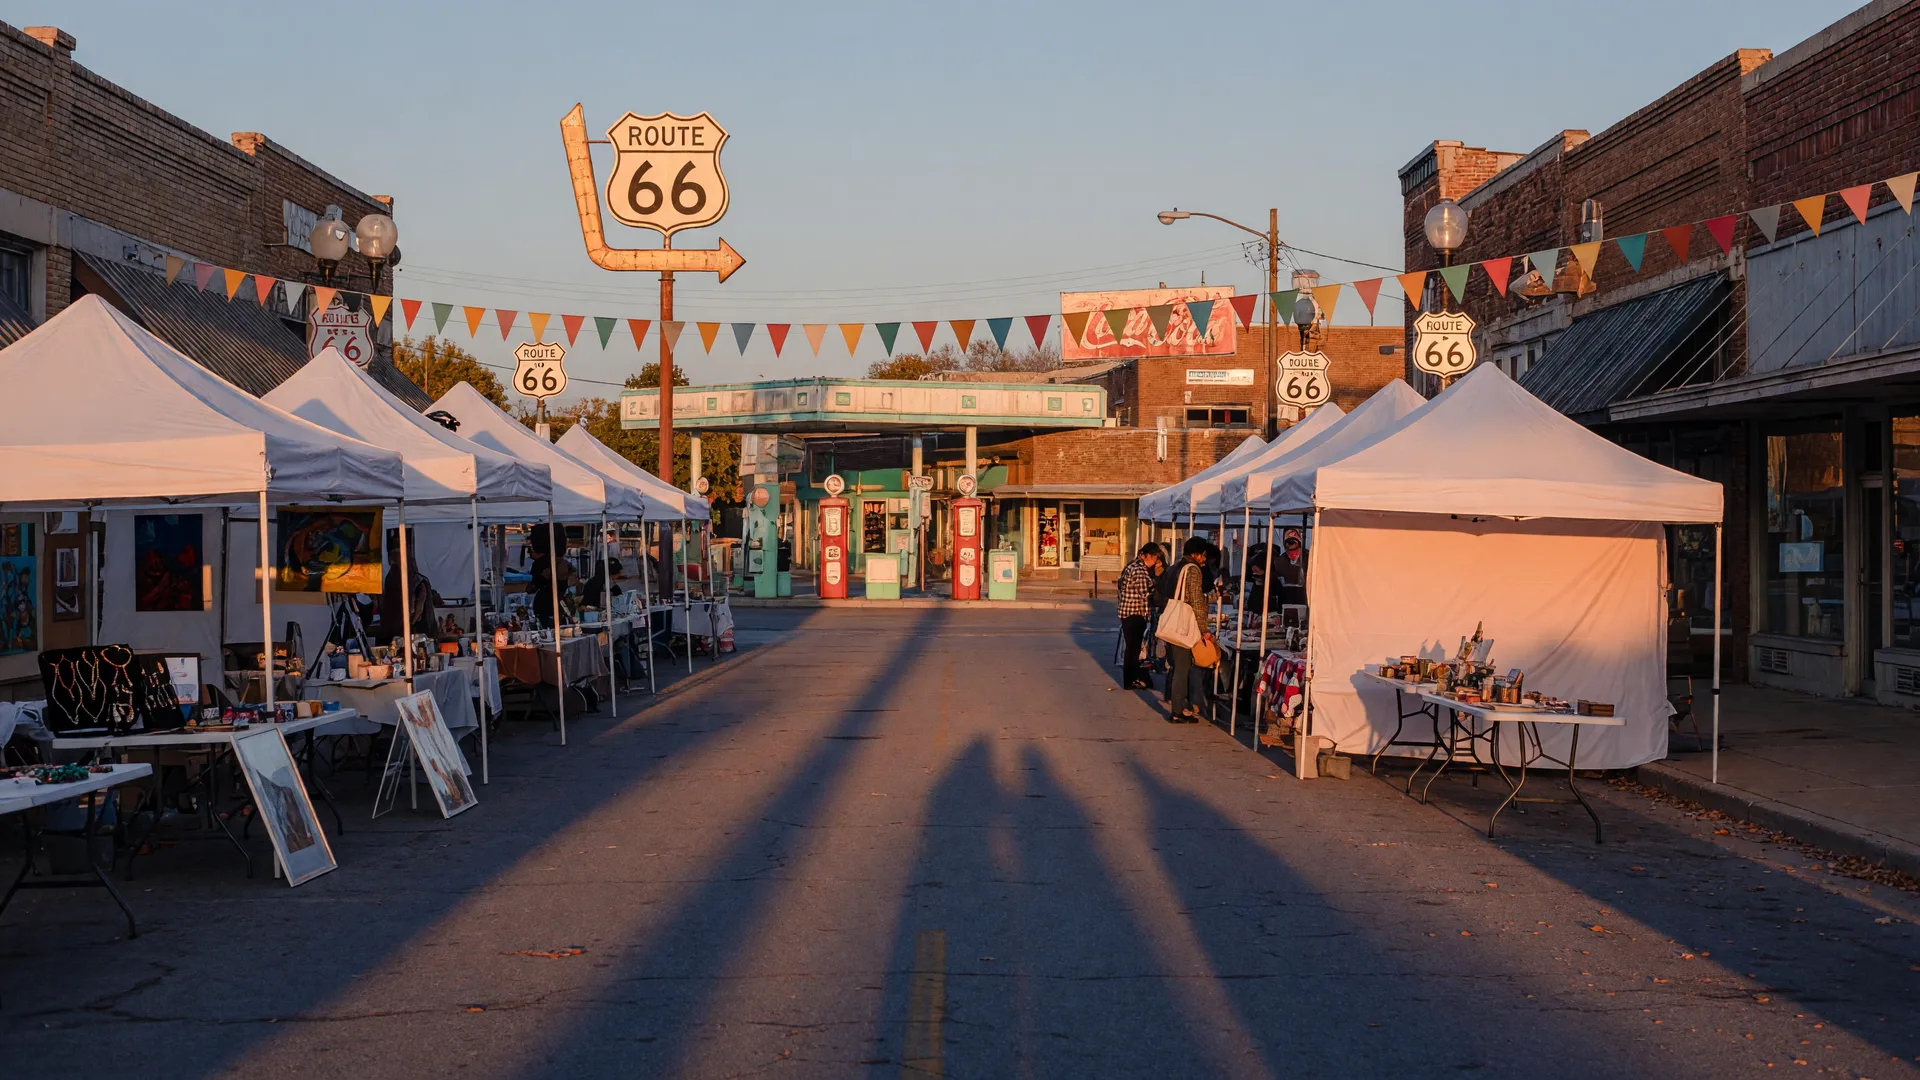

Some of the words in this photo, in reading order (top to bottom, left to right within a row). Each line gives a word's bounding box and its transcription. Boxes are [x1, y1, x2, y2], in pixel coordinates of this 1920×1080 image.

[628, 125, 705, 146] ROUTE
[627, 160, 707, 215] 66
[1426, 320, 1463, 331] ROUTE
[523, 348, 556, 358] ROUTE
[1425, 340, 1465, 367] 66
[522, 367, 557, 391] 66
[1286, 376, 1321, 400] 66
